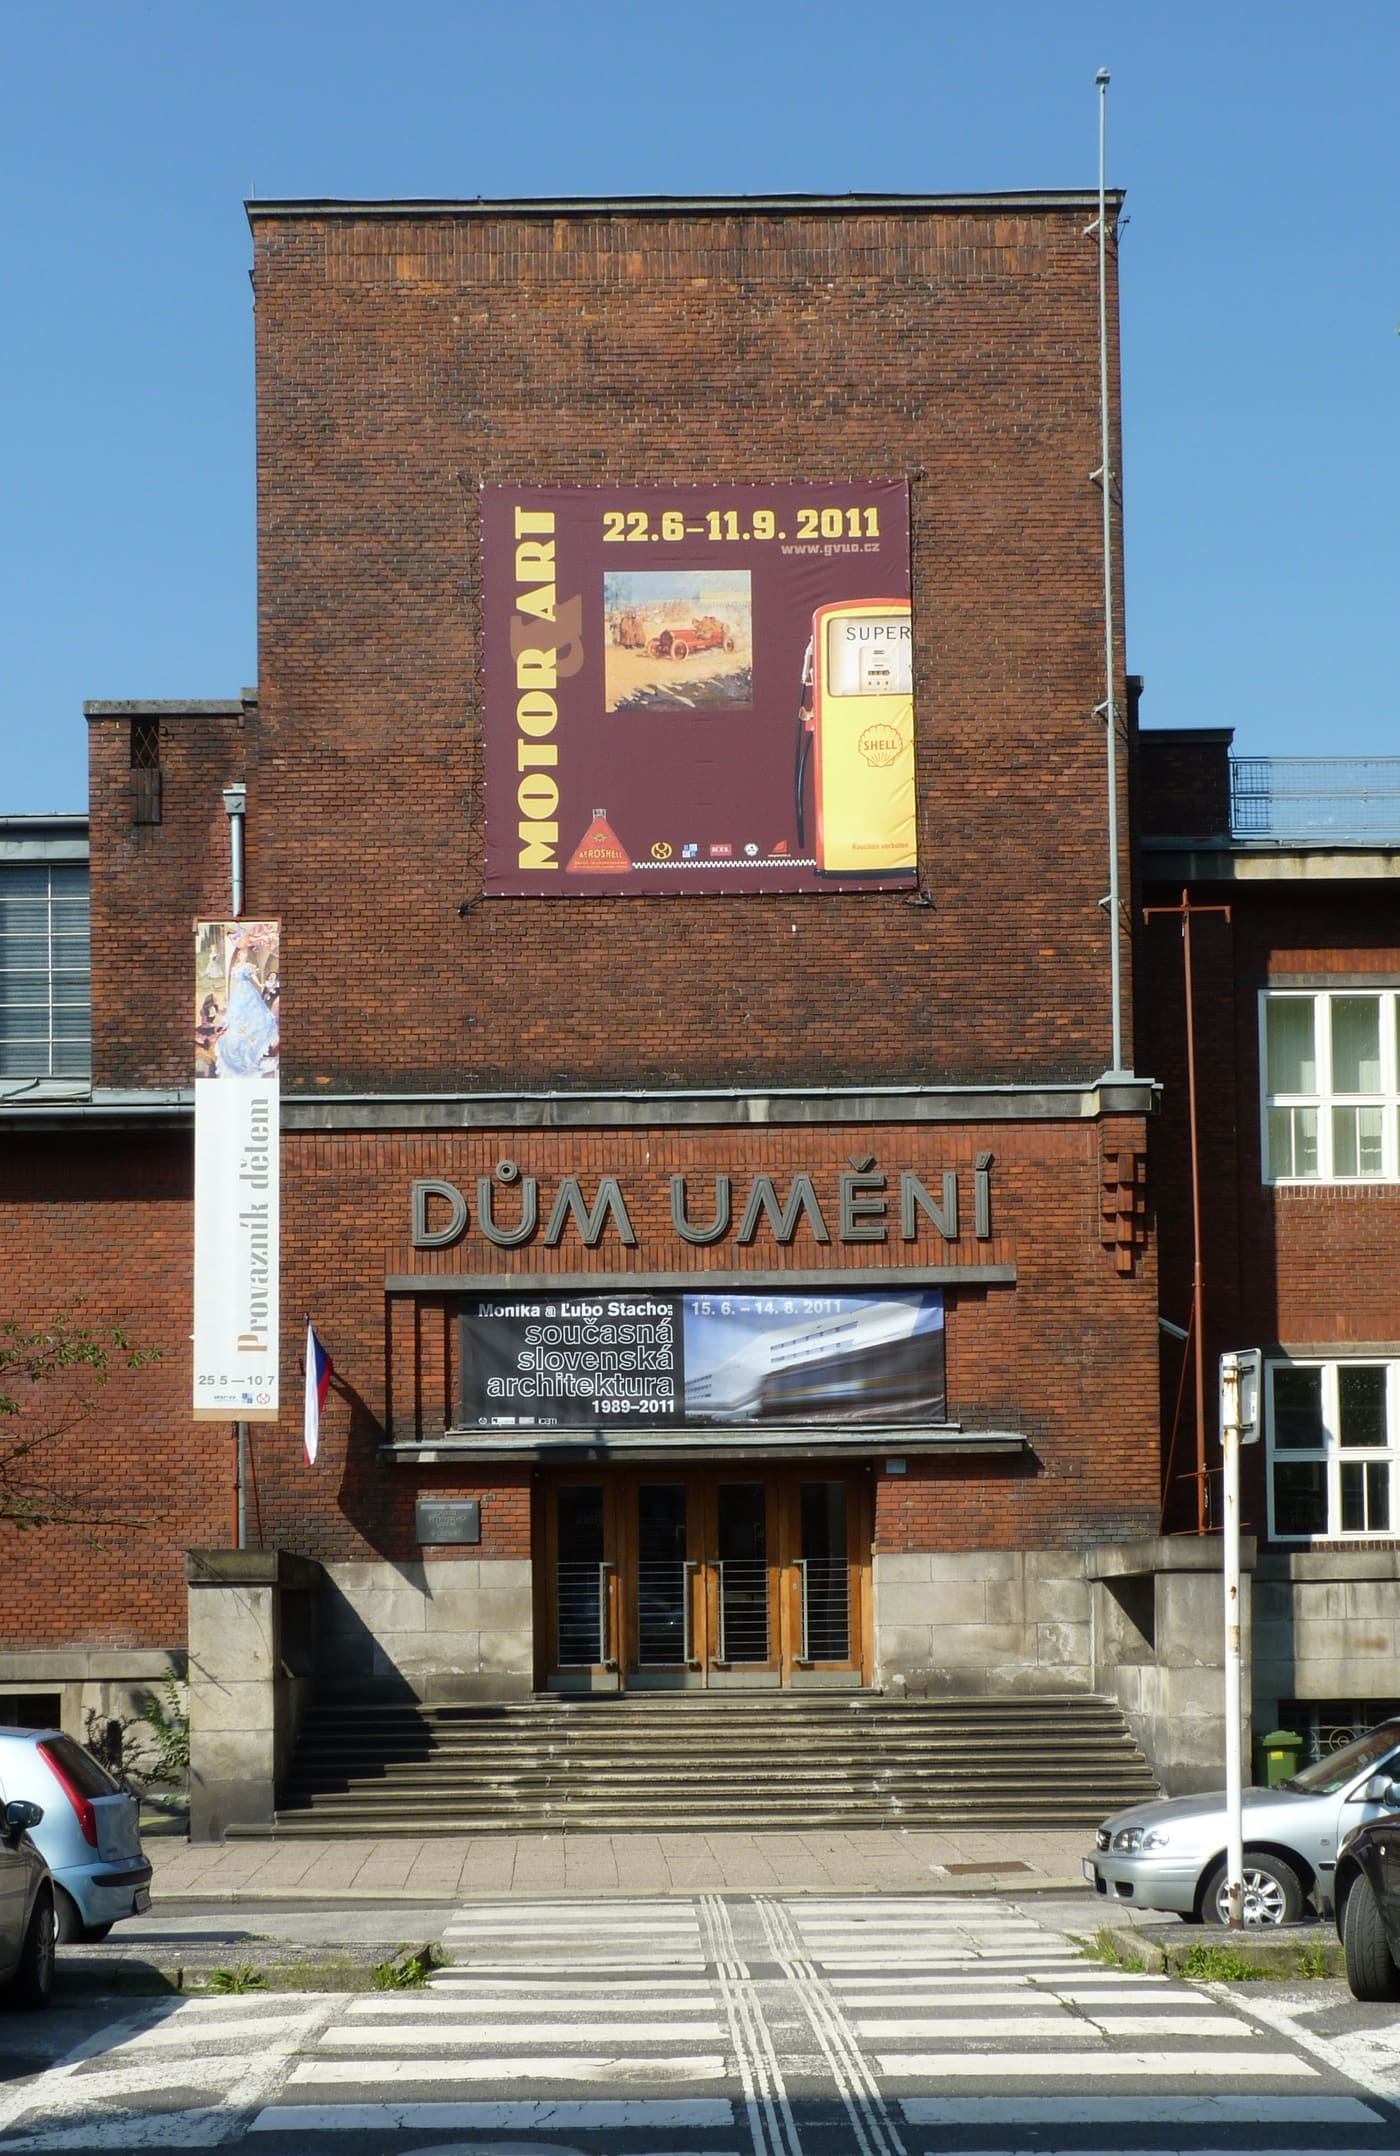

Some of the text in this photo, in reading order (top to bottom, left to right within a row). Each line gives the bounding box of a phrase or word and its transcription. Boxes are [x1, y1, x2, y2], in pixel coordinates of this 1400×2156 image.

[796, 507, 880, 539] 2011
[780, 542, 881, 556] www.gvuo.cz
[846, 625, 911, 641] SUPER
[514, 506, 560, 870] MOTOR ART
[863, 740, 897, 751] SHELL
[578, 848, 622, 858] AEROSHELL
[412, 1152, 994, 1246] DŮM UMĚNÍ
[237, 1098, 269, 1352] Provazník dětem
[478, 1301, 674, 1318] Monika a Ľubo Stacho:
[691, 1301, 716, 1316] 15.
[720, 1301, 736, 1315] 6.
[754, 1301, 779, 1315] 14.
[784, 1301, 799, 1314] 8.
[803, 1300, 842, 1314] 2011
[524, 1317, 674, 1345] současná
[516, 1345, 674, 1371] slovenská
[486, 1372, 675, 1397] architektura
[591, 1400, 675, 1414] 1989–2011
